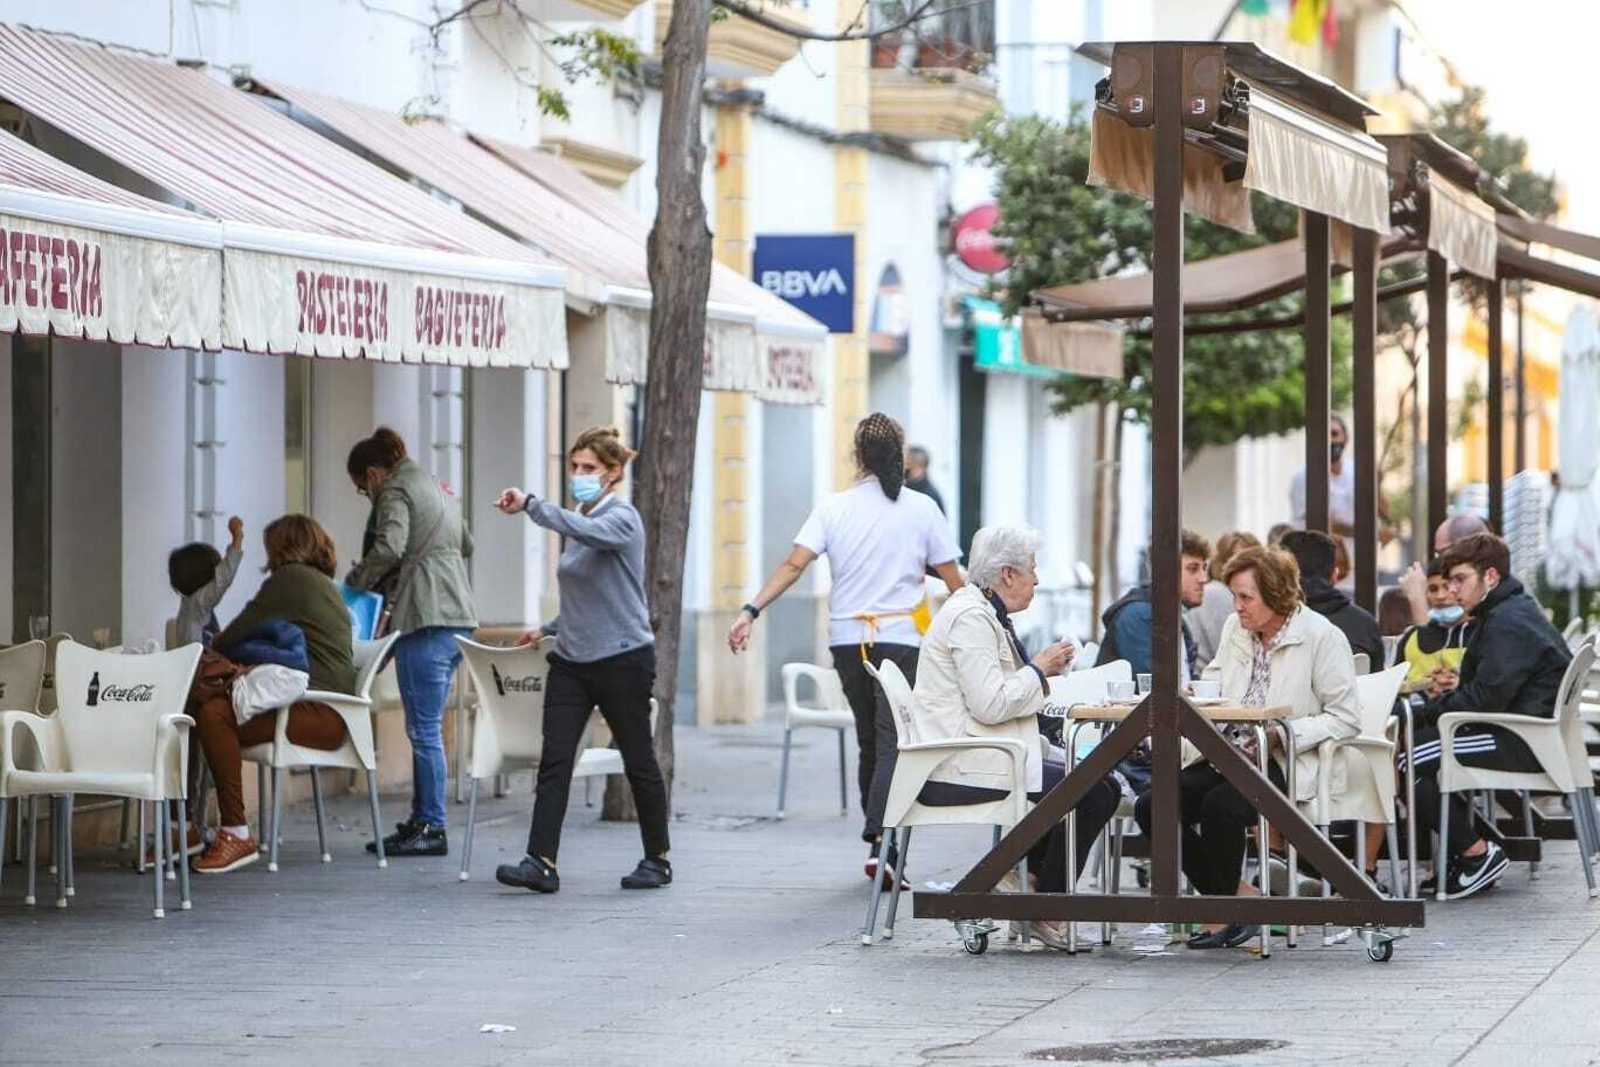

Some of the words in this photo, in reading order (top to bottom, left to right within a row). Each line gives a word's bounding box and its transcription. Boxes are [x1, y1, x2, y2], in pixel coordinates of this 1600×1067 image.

[761, 267, 847, 298] BBVA
[296, 269, 388, 344] PASTELERIA
[101, 684, 156, 702] Coca-Cola
